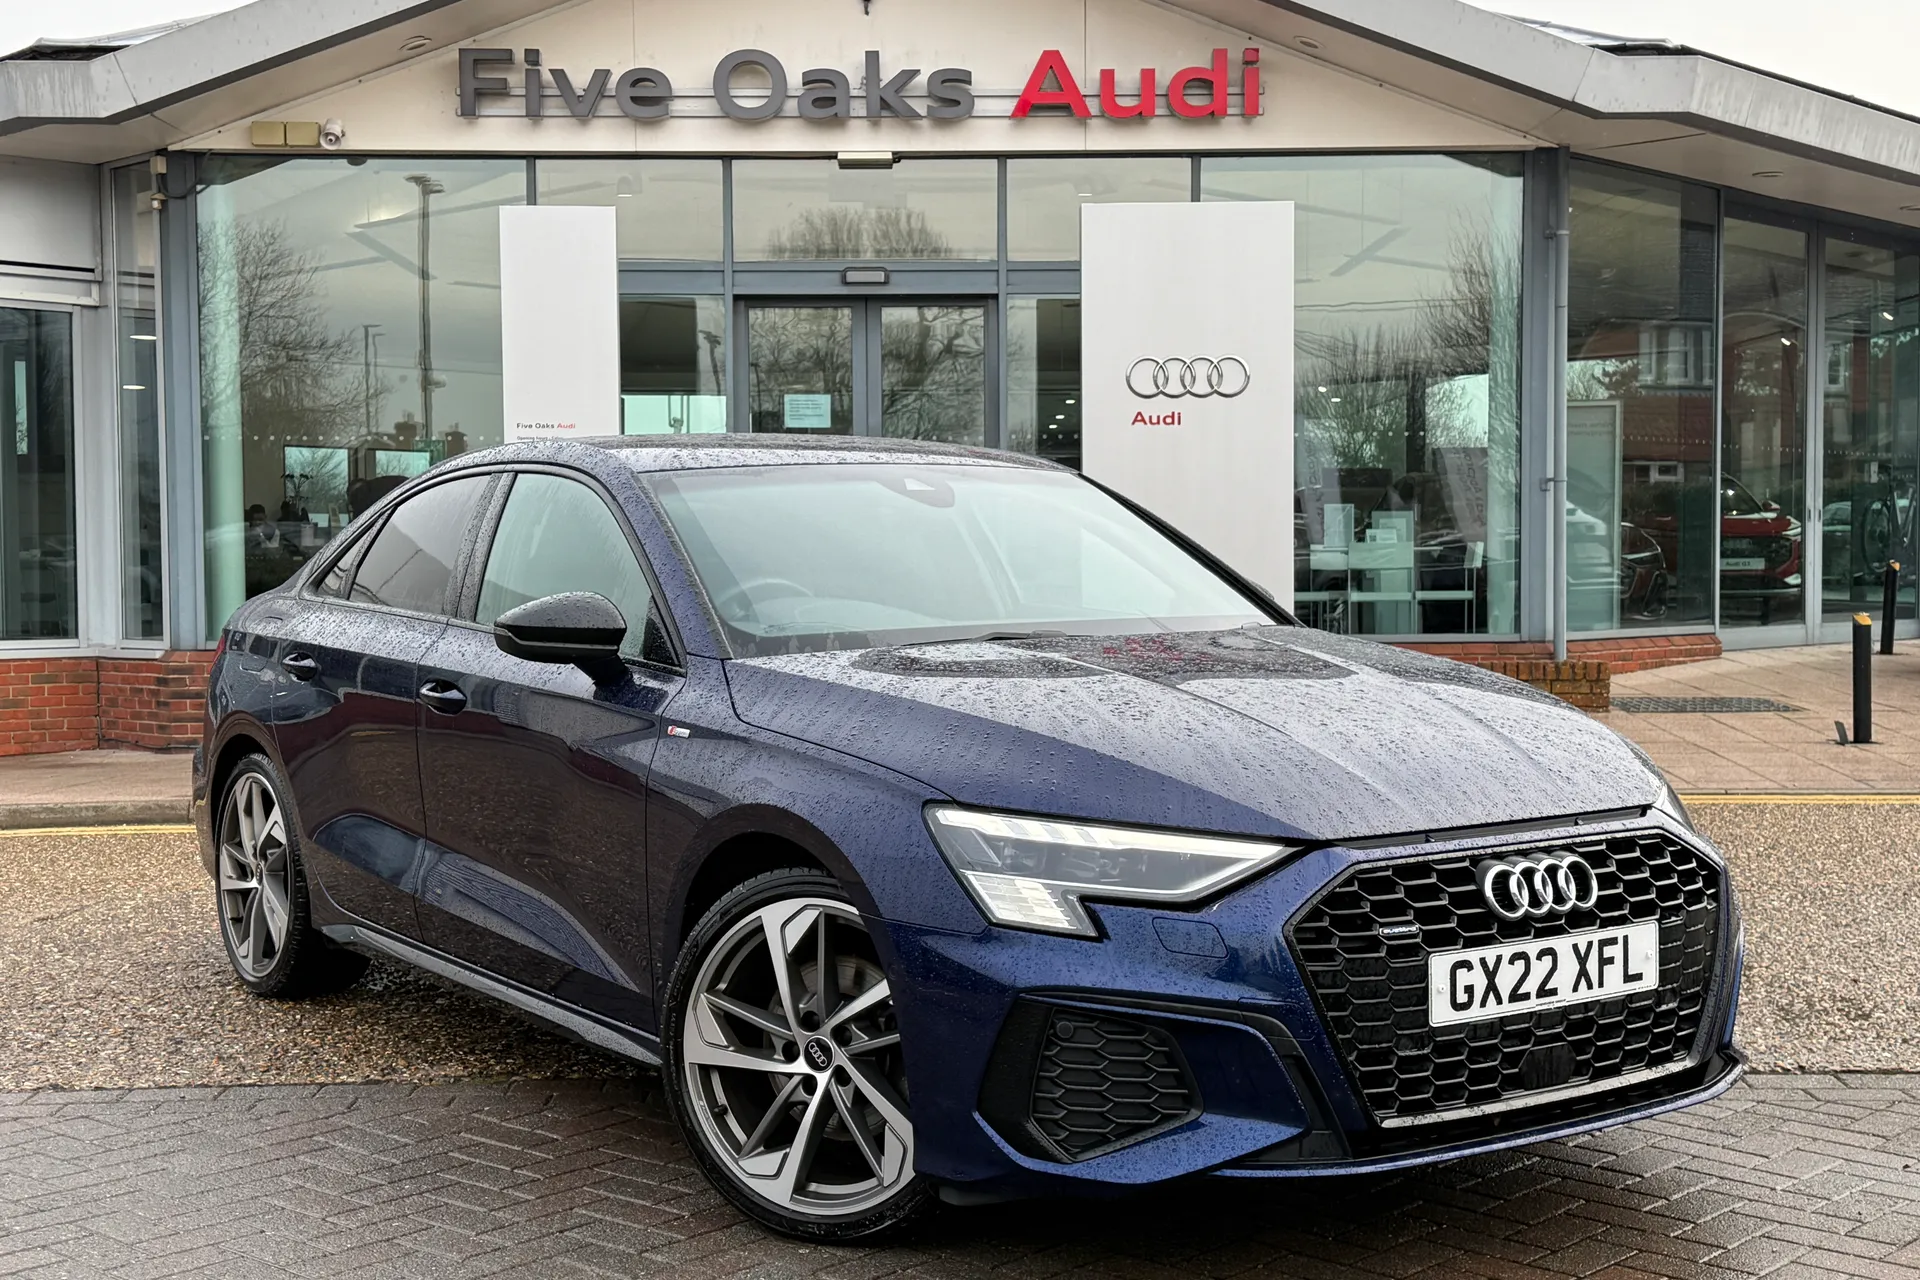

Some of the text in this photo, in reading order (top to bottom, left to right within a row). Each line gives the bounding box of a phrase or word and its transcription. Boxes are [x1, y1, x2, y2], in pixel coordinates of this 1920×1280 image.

[458, 48, 1260, 121] Five Oaks Audi
[1131, 411, 1182, 426] Audi
[1449, 935, 1644, 1012] GX22 XFL
